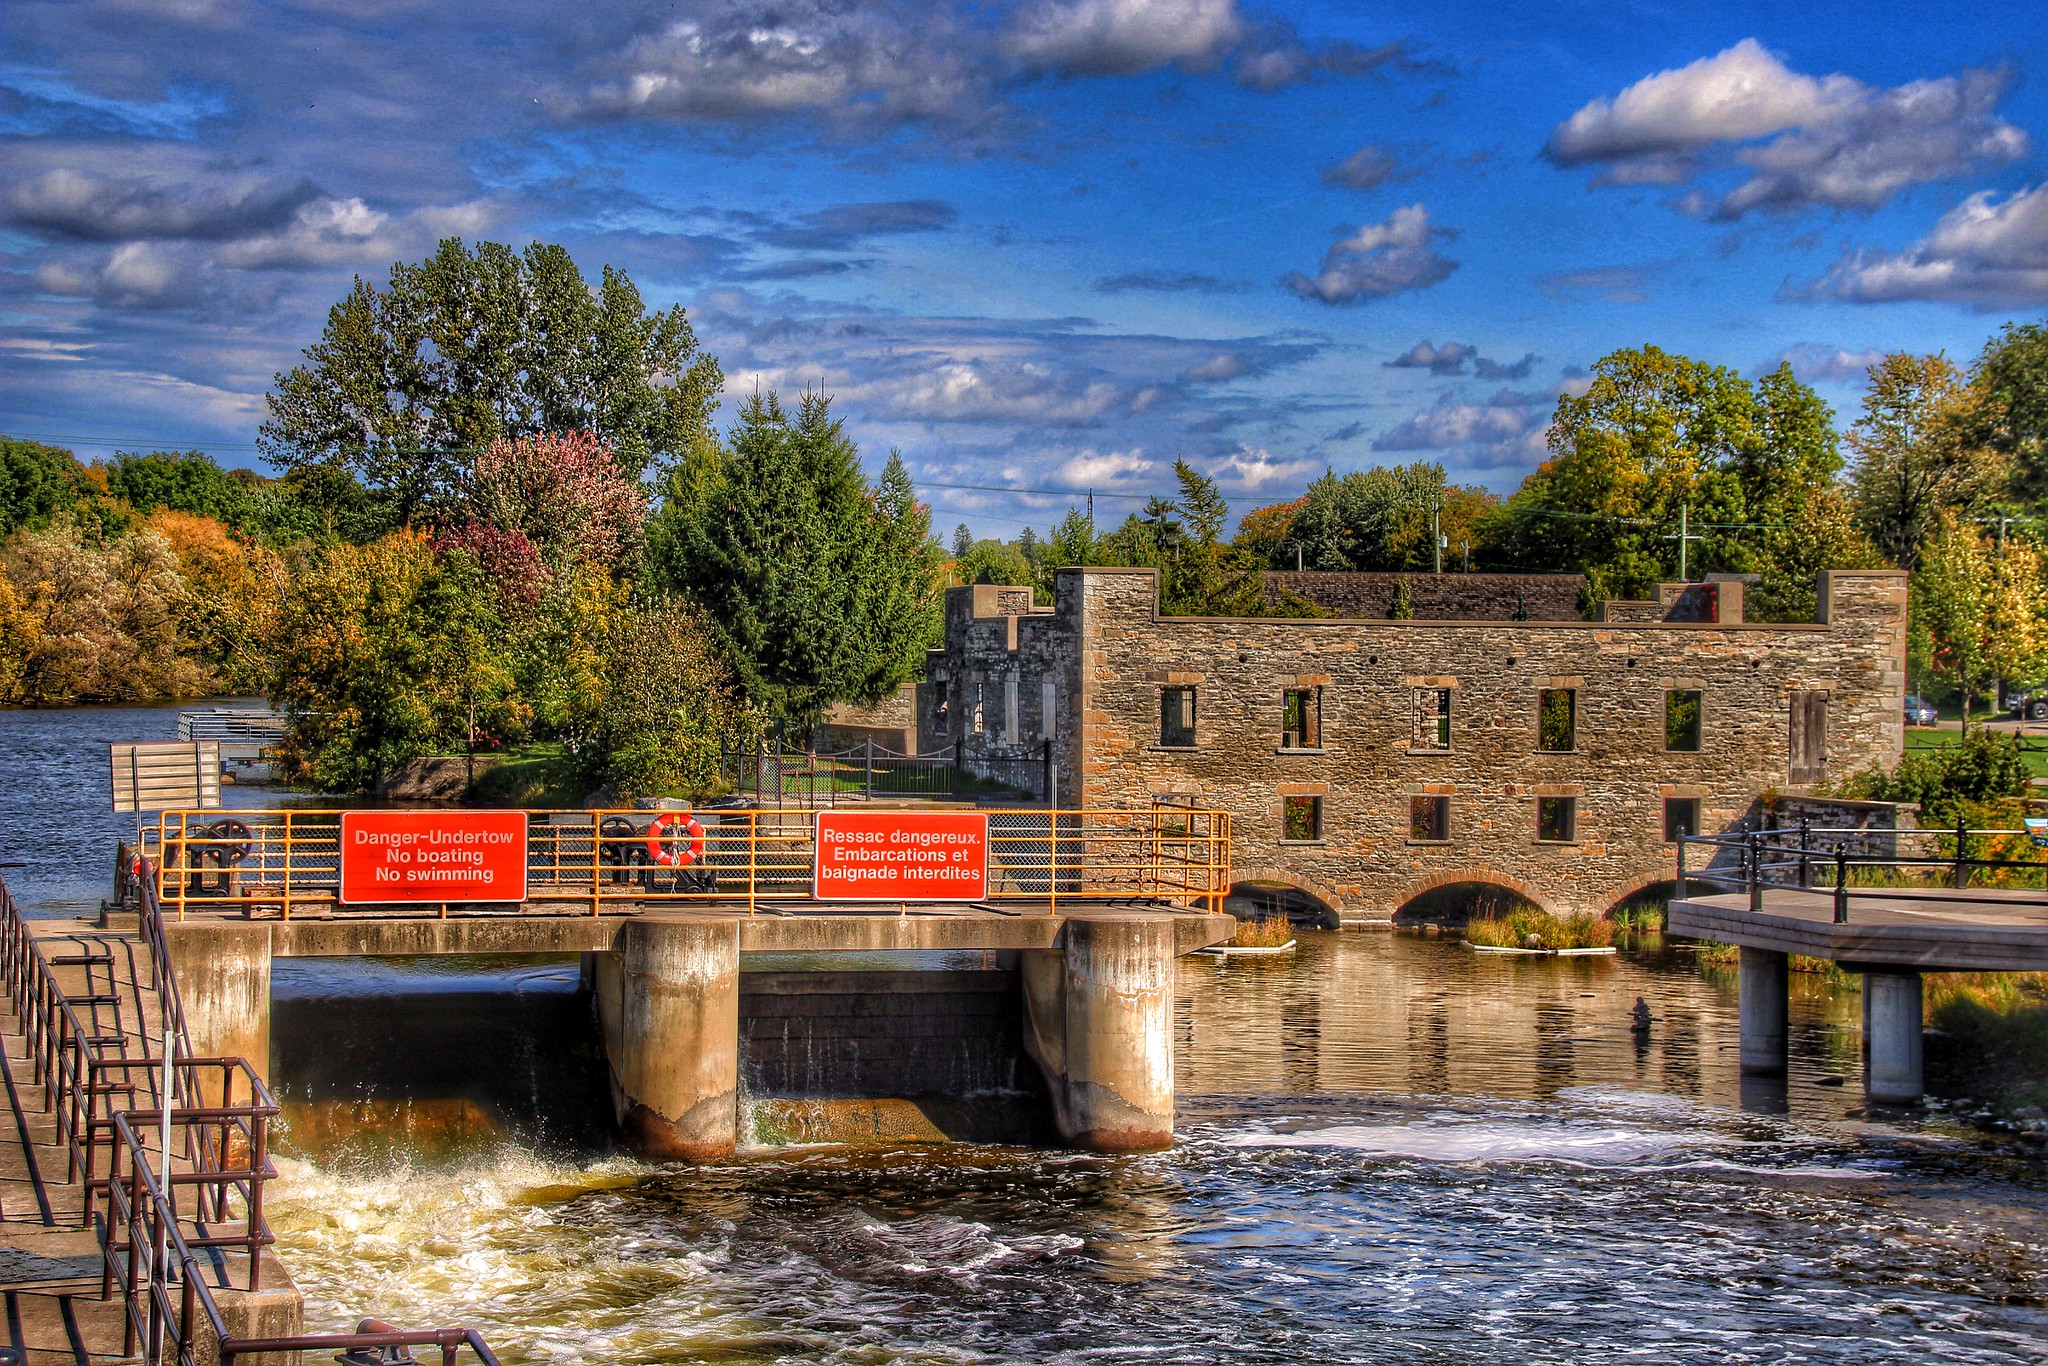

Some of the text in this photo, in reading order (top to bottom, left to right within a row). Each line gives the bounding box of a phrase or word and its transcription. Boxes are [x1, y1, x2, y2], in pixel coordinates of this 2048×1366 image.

[355, 830, 513, 847] Danger-Undertow
[823, 829, 981, 846] Ressac dangereux.
[386, 848, 484, 865] No boating
[834, 847, 969, 862] Embarcations et
[376, 867, 494, 884] No swimming
[822, 865, 980, 882] baignade interdites
